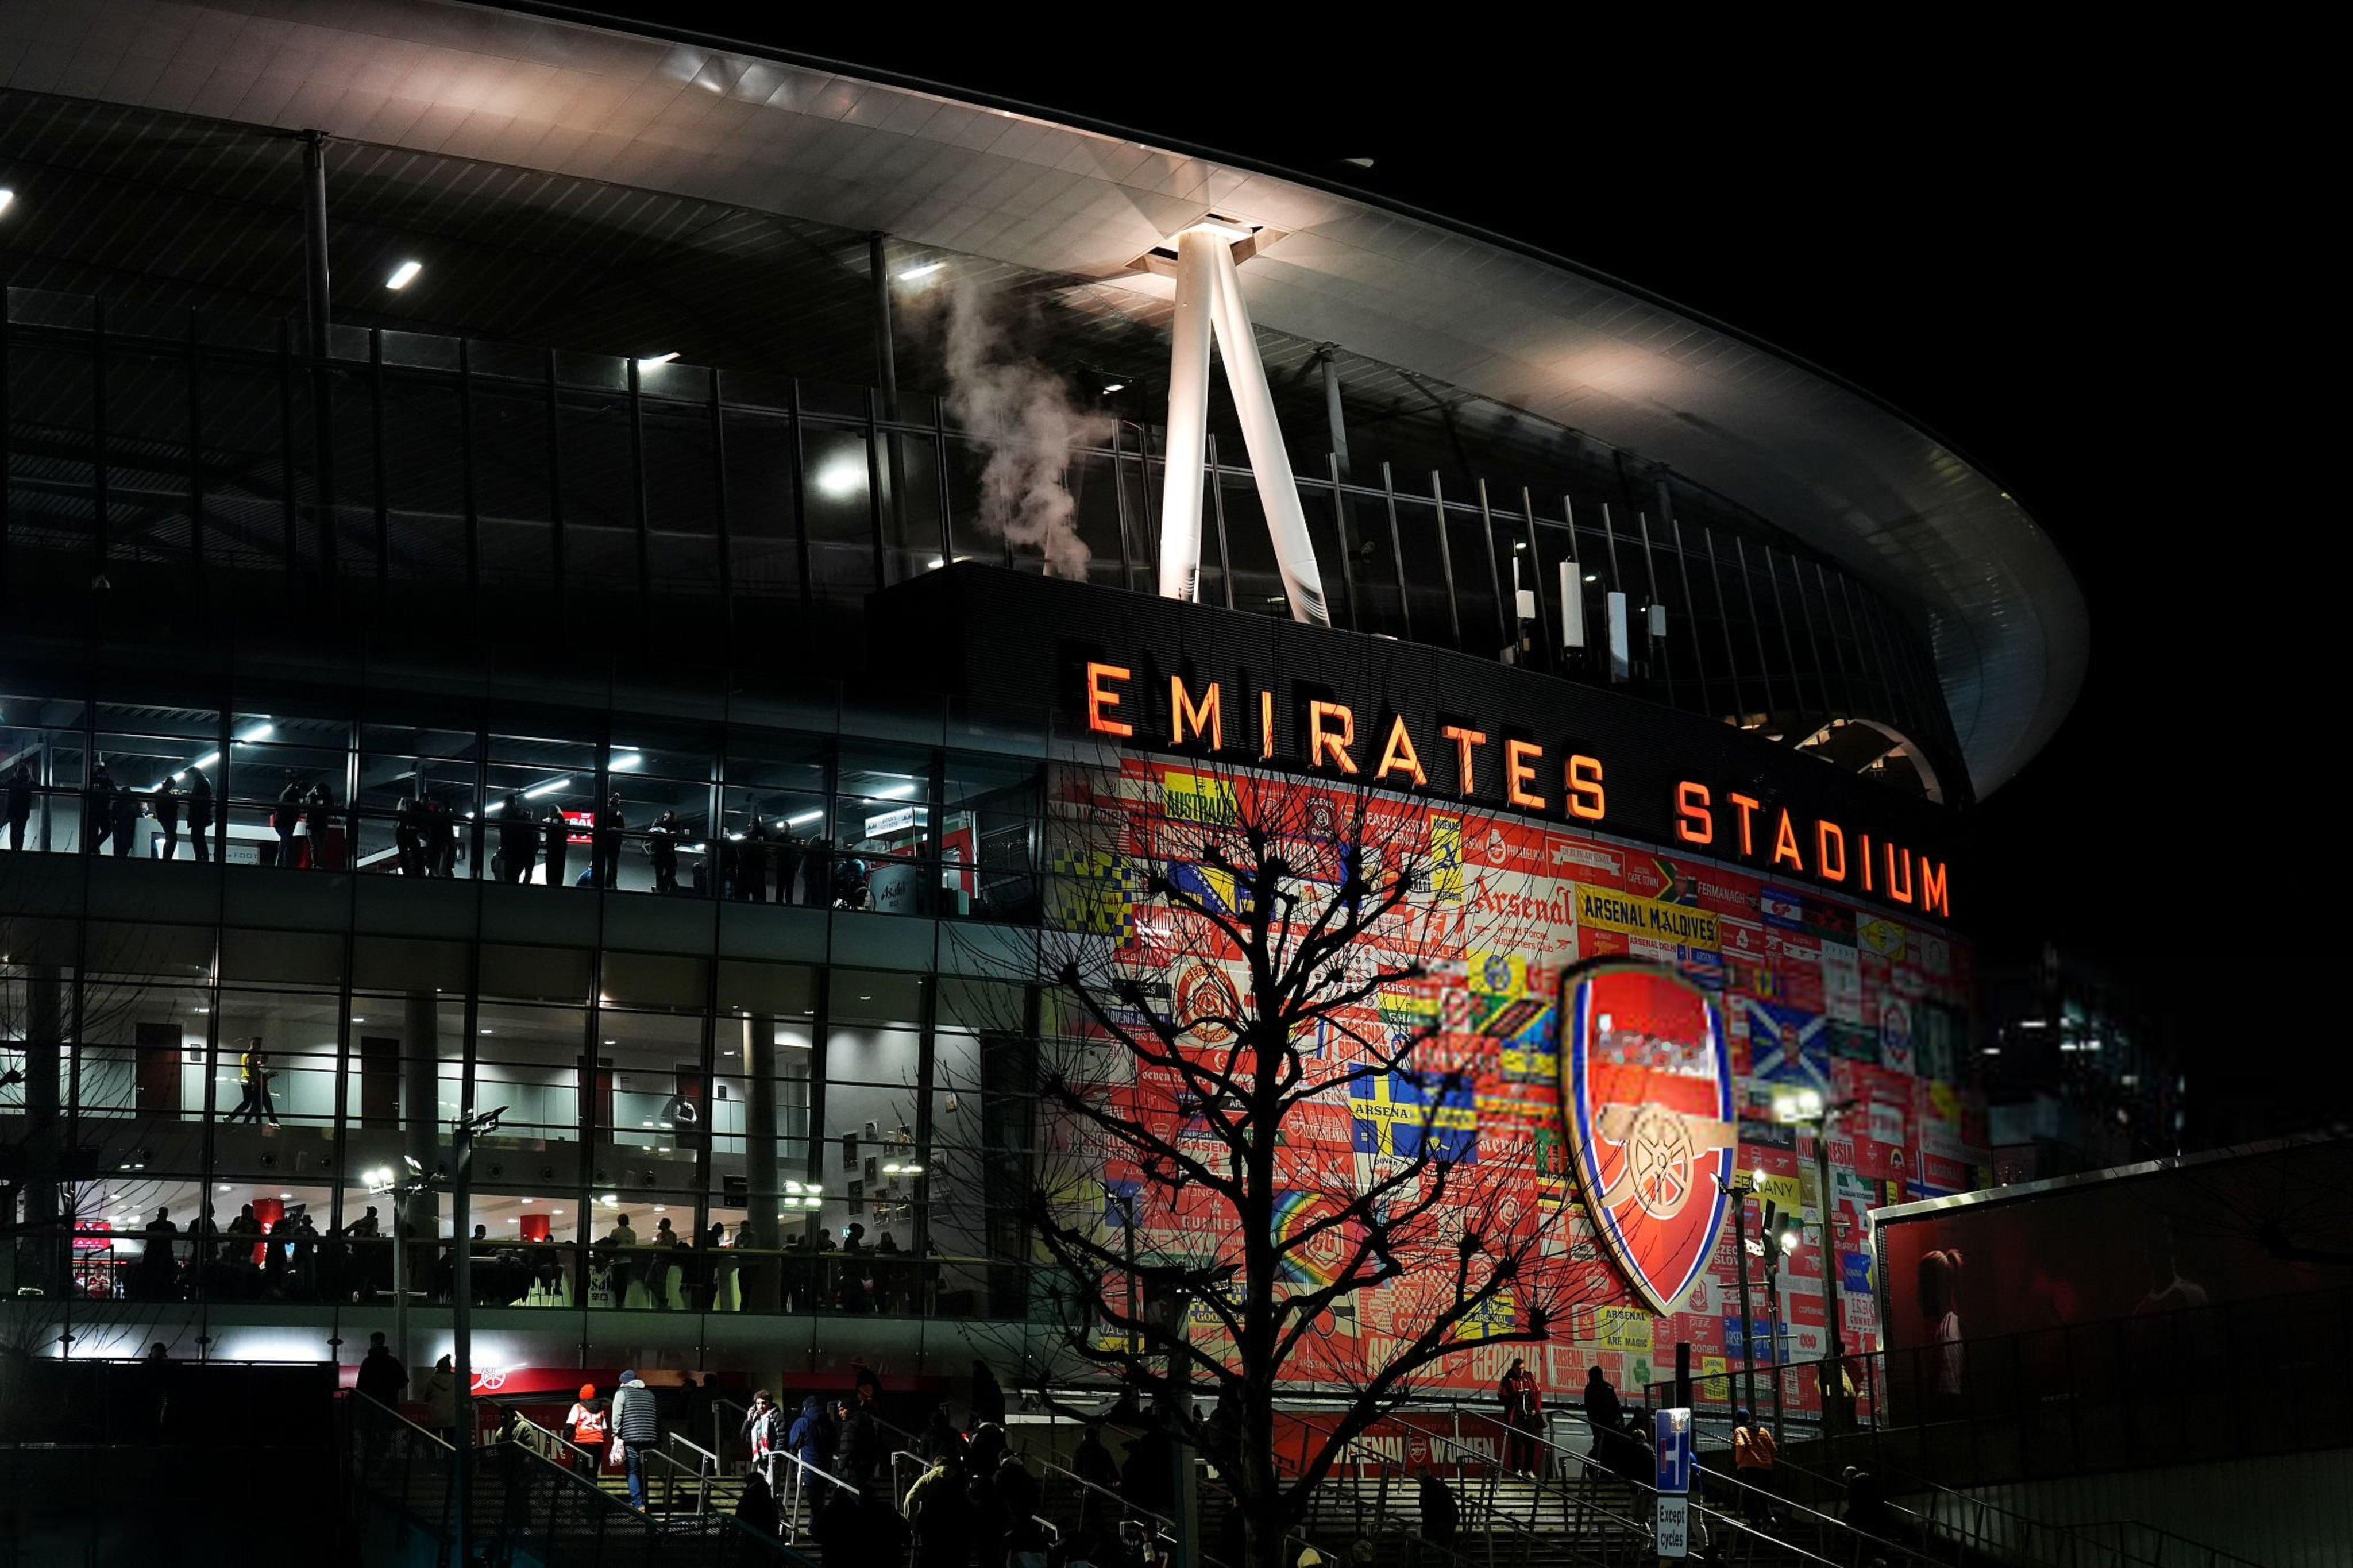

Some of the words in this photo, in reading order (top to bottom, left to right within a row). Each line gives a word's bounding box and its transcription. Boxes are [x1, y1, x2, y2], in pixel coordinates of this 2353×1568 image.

[1088, 662, 1604, 820] EMIRATES
[1676, 781, 1949, 917] STADIUM
[1475, 875, 1573, 926] Arsenal
[1698, 882, 1745, 903] FERMANAGH
[1586, 895, 1646, 928] ARSENAL
[1650, 906, 1715, 941] MALDIVES
[1498, 924, 1522, 936] Armed
[1524, 926, 1549, 940] Forces
[1379, 939, 1421, 951] NORTH
[1425, 944, 1464, 959] WALES
[1494, 934, 1536, 949] Supporters
[1537, 943, 1554, 952] Club
[1107, 1009, 1134, 1024] LOVENIA
[1356, 1104, 1410, 1118] ARSENA
[1606, 1310, 1646, 1321] ARSENAL
[1608, 1337, 1622, 1346] ARE
[1625, 1337, 1648, 1348] MAGIC
[1684, 1340, 1719, 1354] ooners
[1660, 1505, 1684, 1527] Except
[1661, 1529, 1684, 1550] cycles
